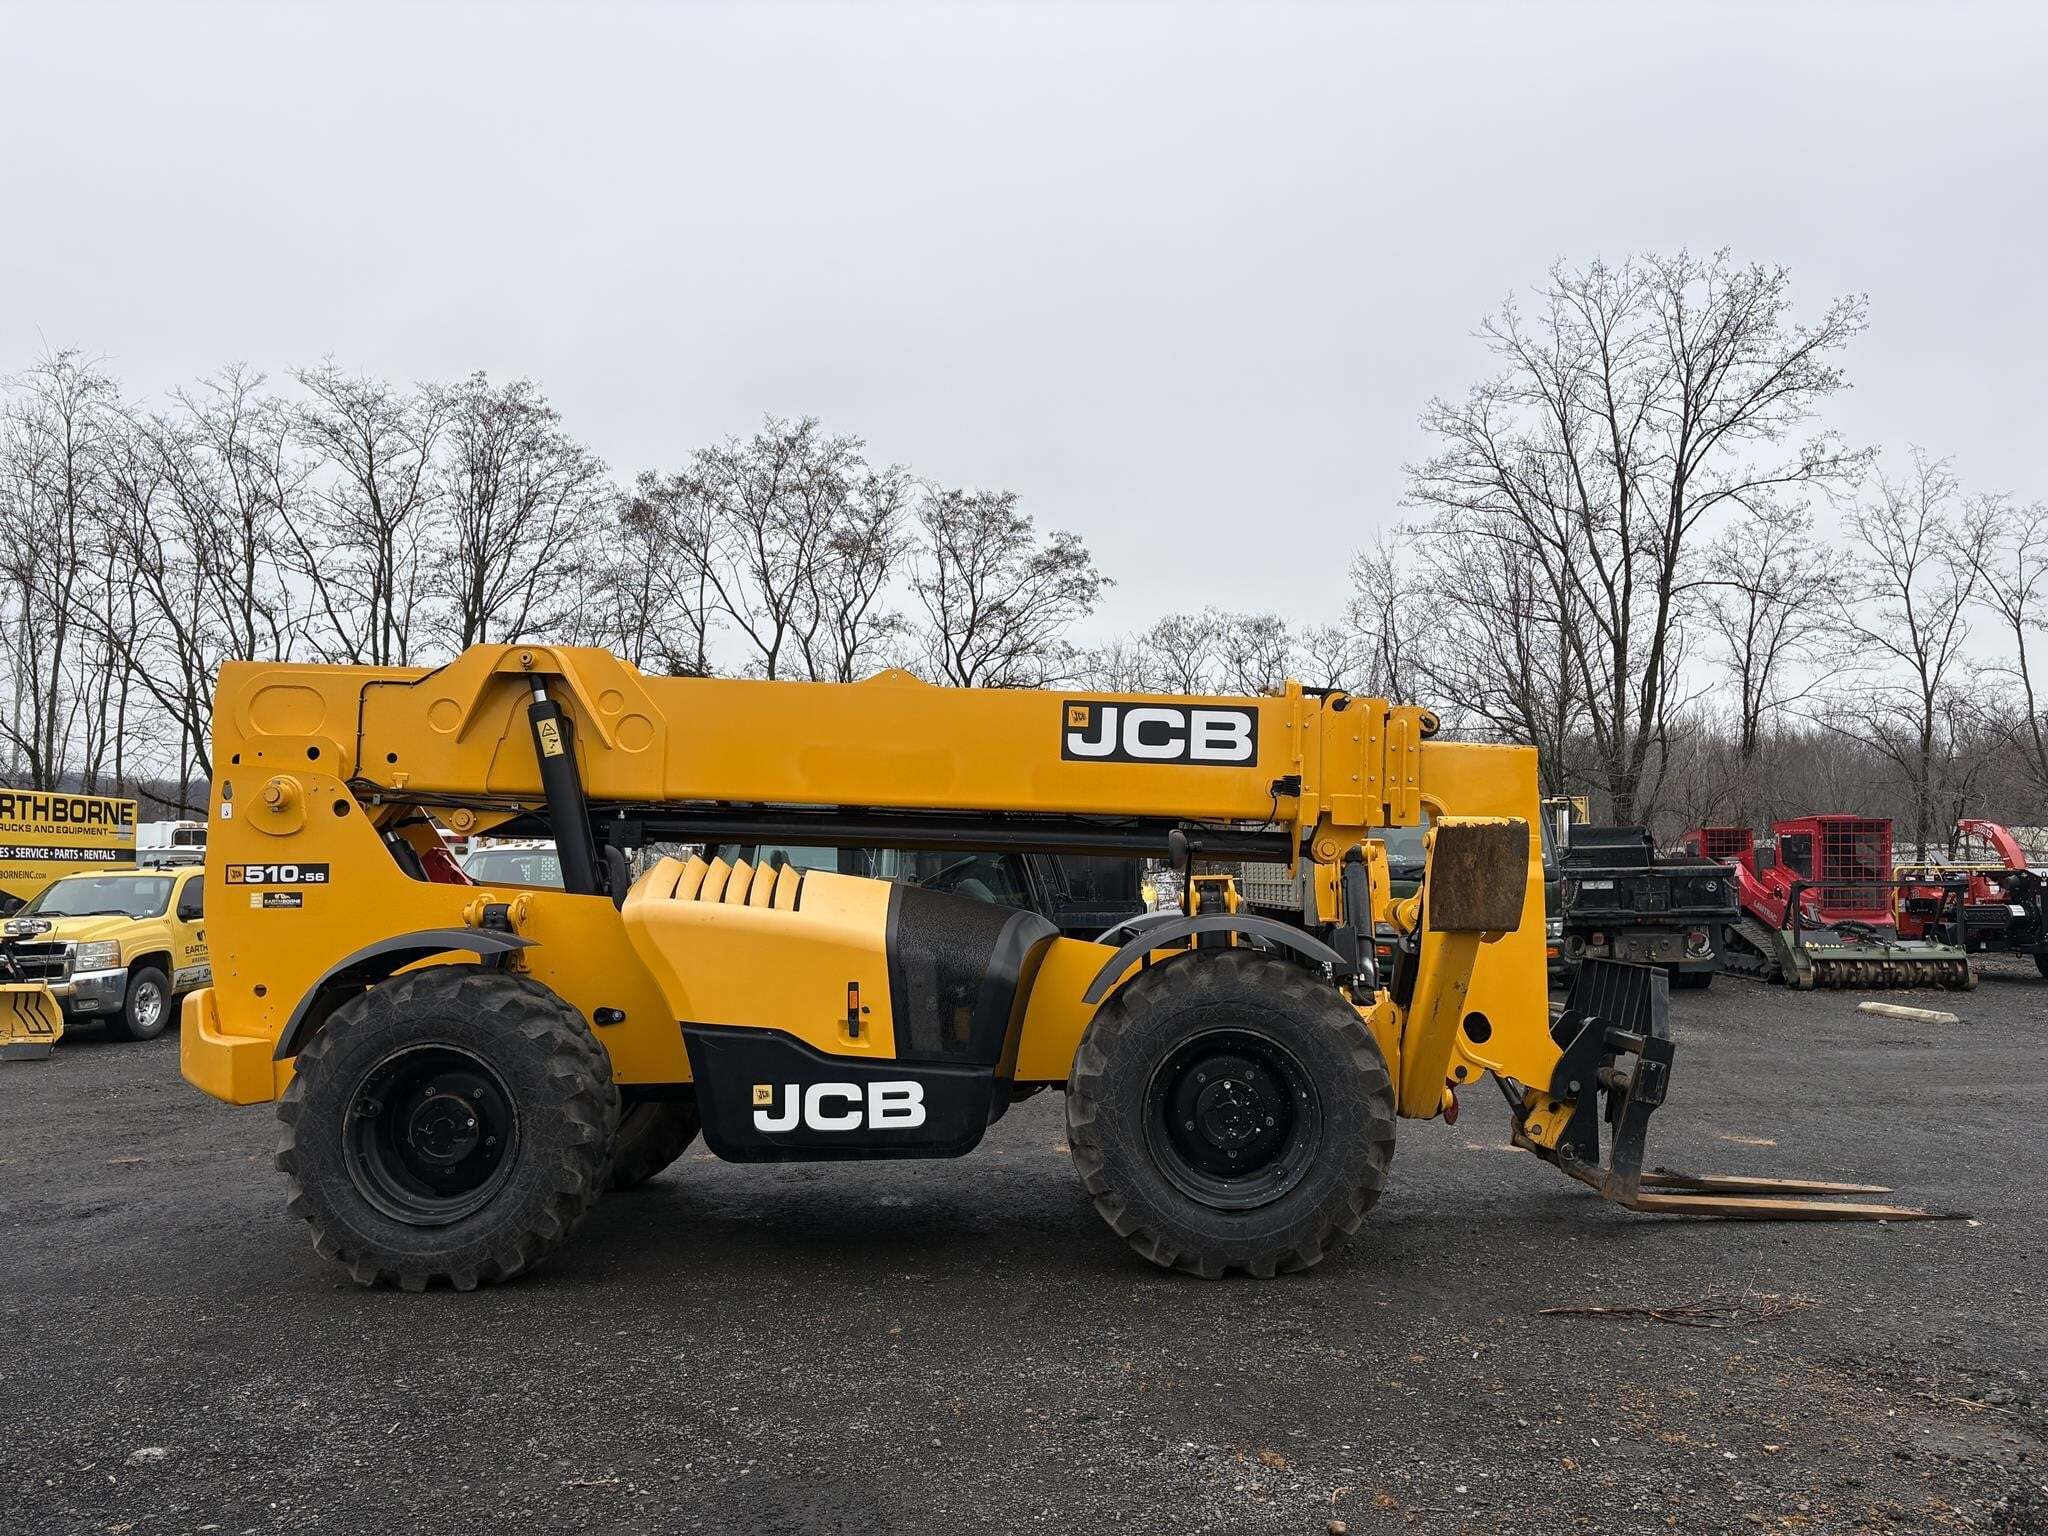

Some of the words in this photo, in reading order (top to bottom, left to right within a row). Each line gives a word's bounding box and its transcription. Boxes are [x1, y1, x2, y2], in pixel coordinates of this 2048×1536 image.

[1067, 707, 1253, 761] JCB
[0, 794, 133, 825] RTHBORNE
[34, 825, 54, 834] AND
[56, 826, 108, 836] EQUIPMENT
[15, 848, 49, 859] SERVICE
[54, 849, 78, 859] PARTS
[84, 850, 116, 860] RENTALS
[245, 866, 325, 882] 510-56
[753, 1081, 926, 1131] JCB
